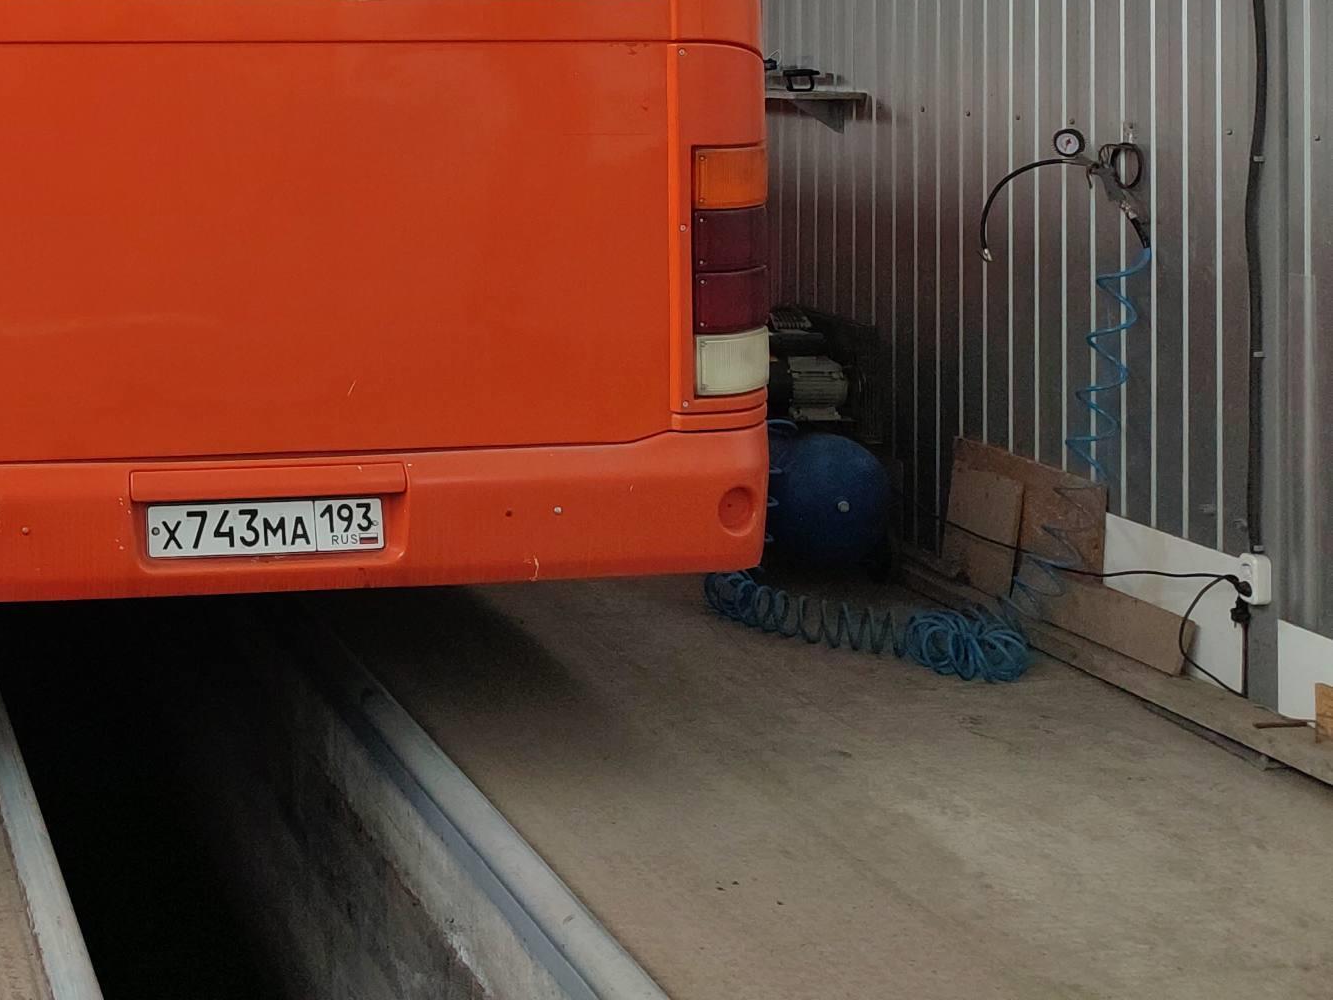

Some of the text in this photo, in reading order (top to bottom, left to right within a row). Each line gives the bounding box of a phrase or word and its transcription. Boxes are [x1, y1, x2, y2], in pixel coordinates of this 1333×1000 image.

[161, 502, 373, 550] Х743МА 193
[331, 534, 359, 545] RUS
